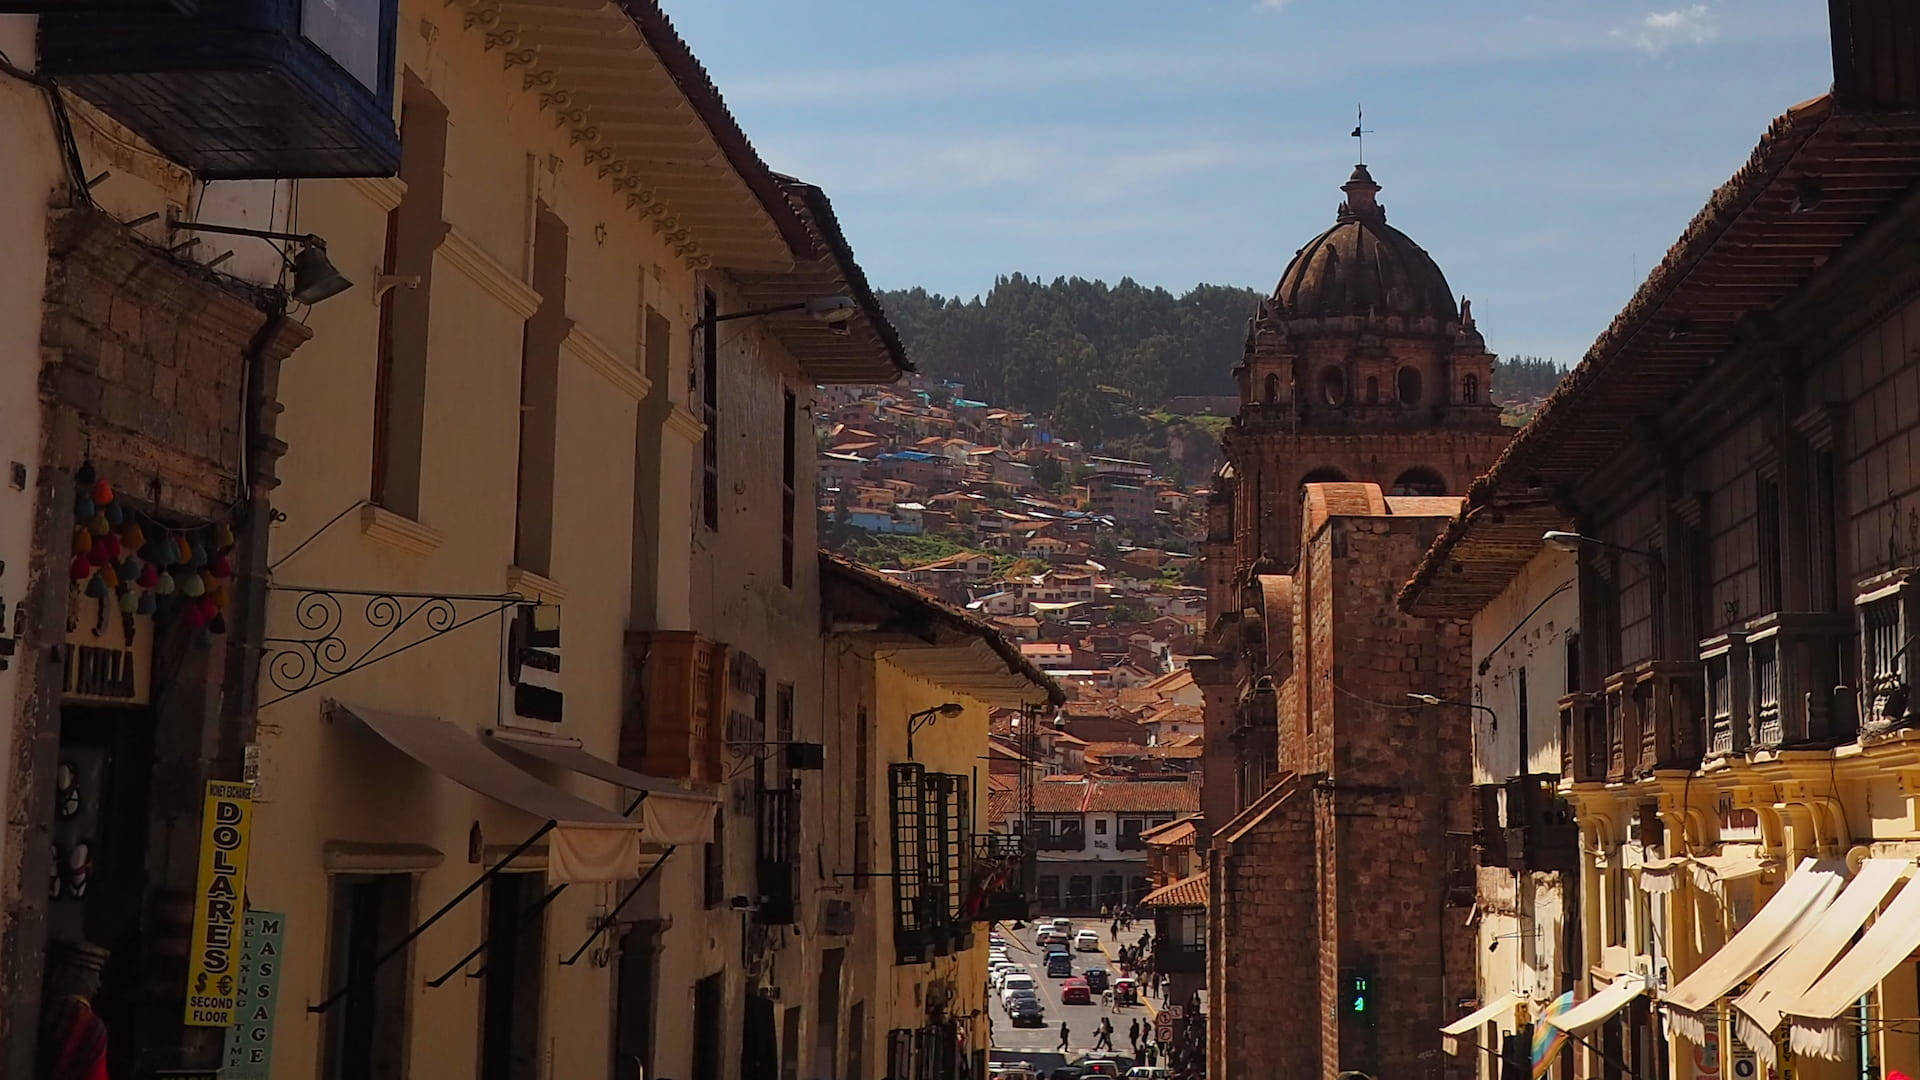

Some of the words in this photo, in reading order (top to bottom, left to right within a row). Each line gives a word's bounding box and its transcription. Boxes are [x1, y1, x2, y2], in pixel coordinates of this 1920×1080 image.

[202, 801, 242, 974] DOLARES
[236, 917, 256, 1008] RELAXING
[250, 919, 280, 1064] MASSAGE
[190, 996, 233, 1009] SECOND
[193, 1010, 228, 1023] FLOOR
[229, 1023, 246, 1067] TIME
